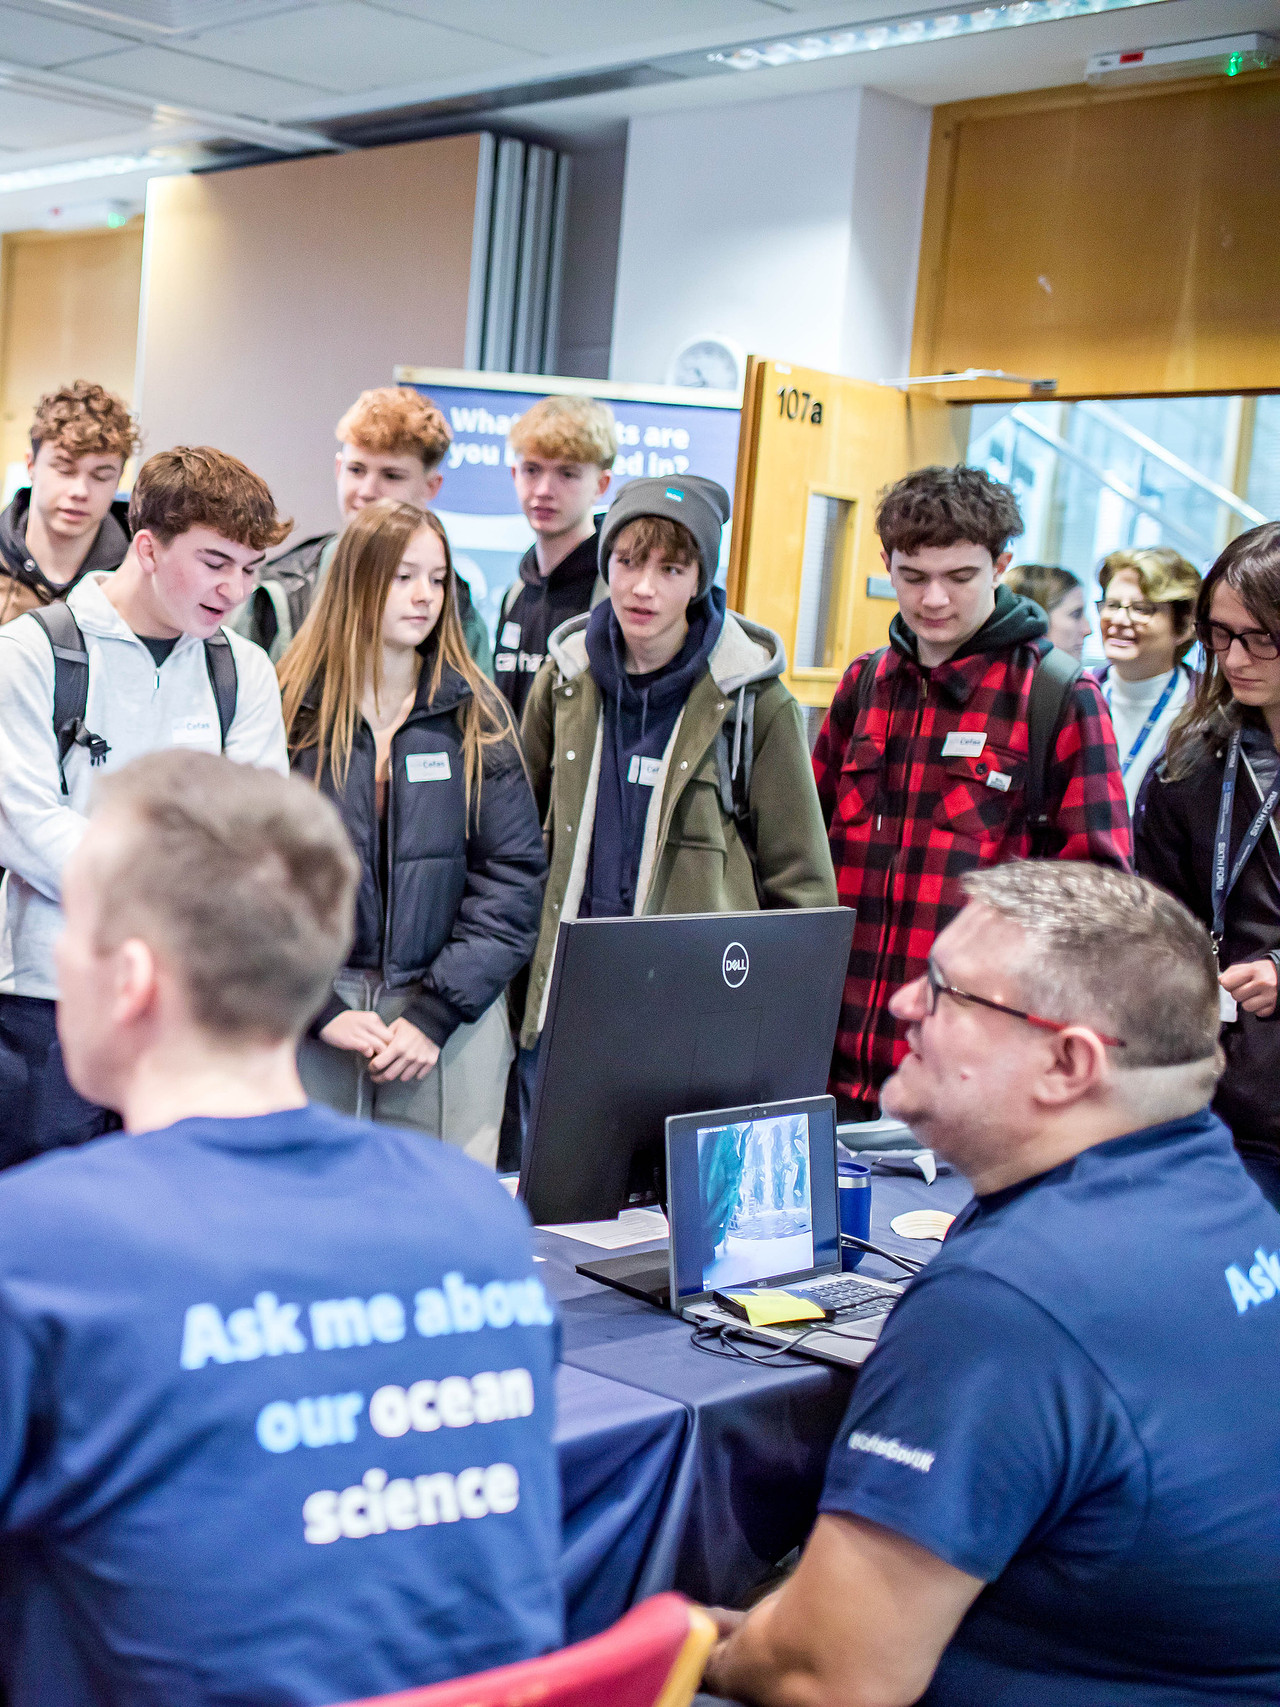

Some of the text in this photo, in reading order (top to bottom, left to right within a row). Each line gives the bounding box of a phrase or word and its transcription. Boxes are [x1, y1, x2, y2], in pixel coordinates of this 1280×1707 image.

[777, 387, 823, 425] 107a
[643, 425, 690, 450] are
[447, 441, 500, 470] you
[1249, 790, 1279, 837] SIXTH FORM
[1217, 841, 1226, 866] SIXTH
[1215, 866, 1225, 890] FORM
[725, 958, 747, 972] DELL
[181, 1292, 307, 1370] Ask
[310, 1293, 407, 1350] me
[256, 1368, 535, 1454] our ocean
[302, 1464, 520, 1545] science
